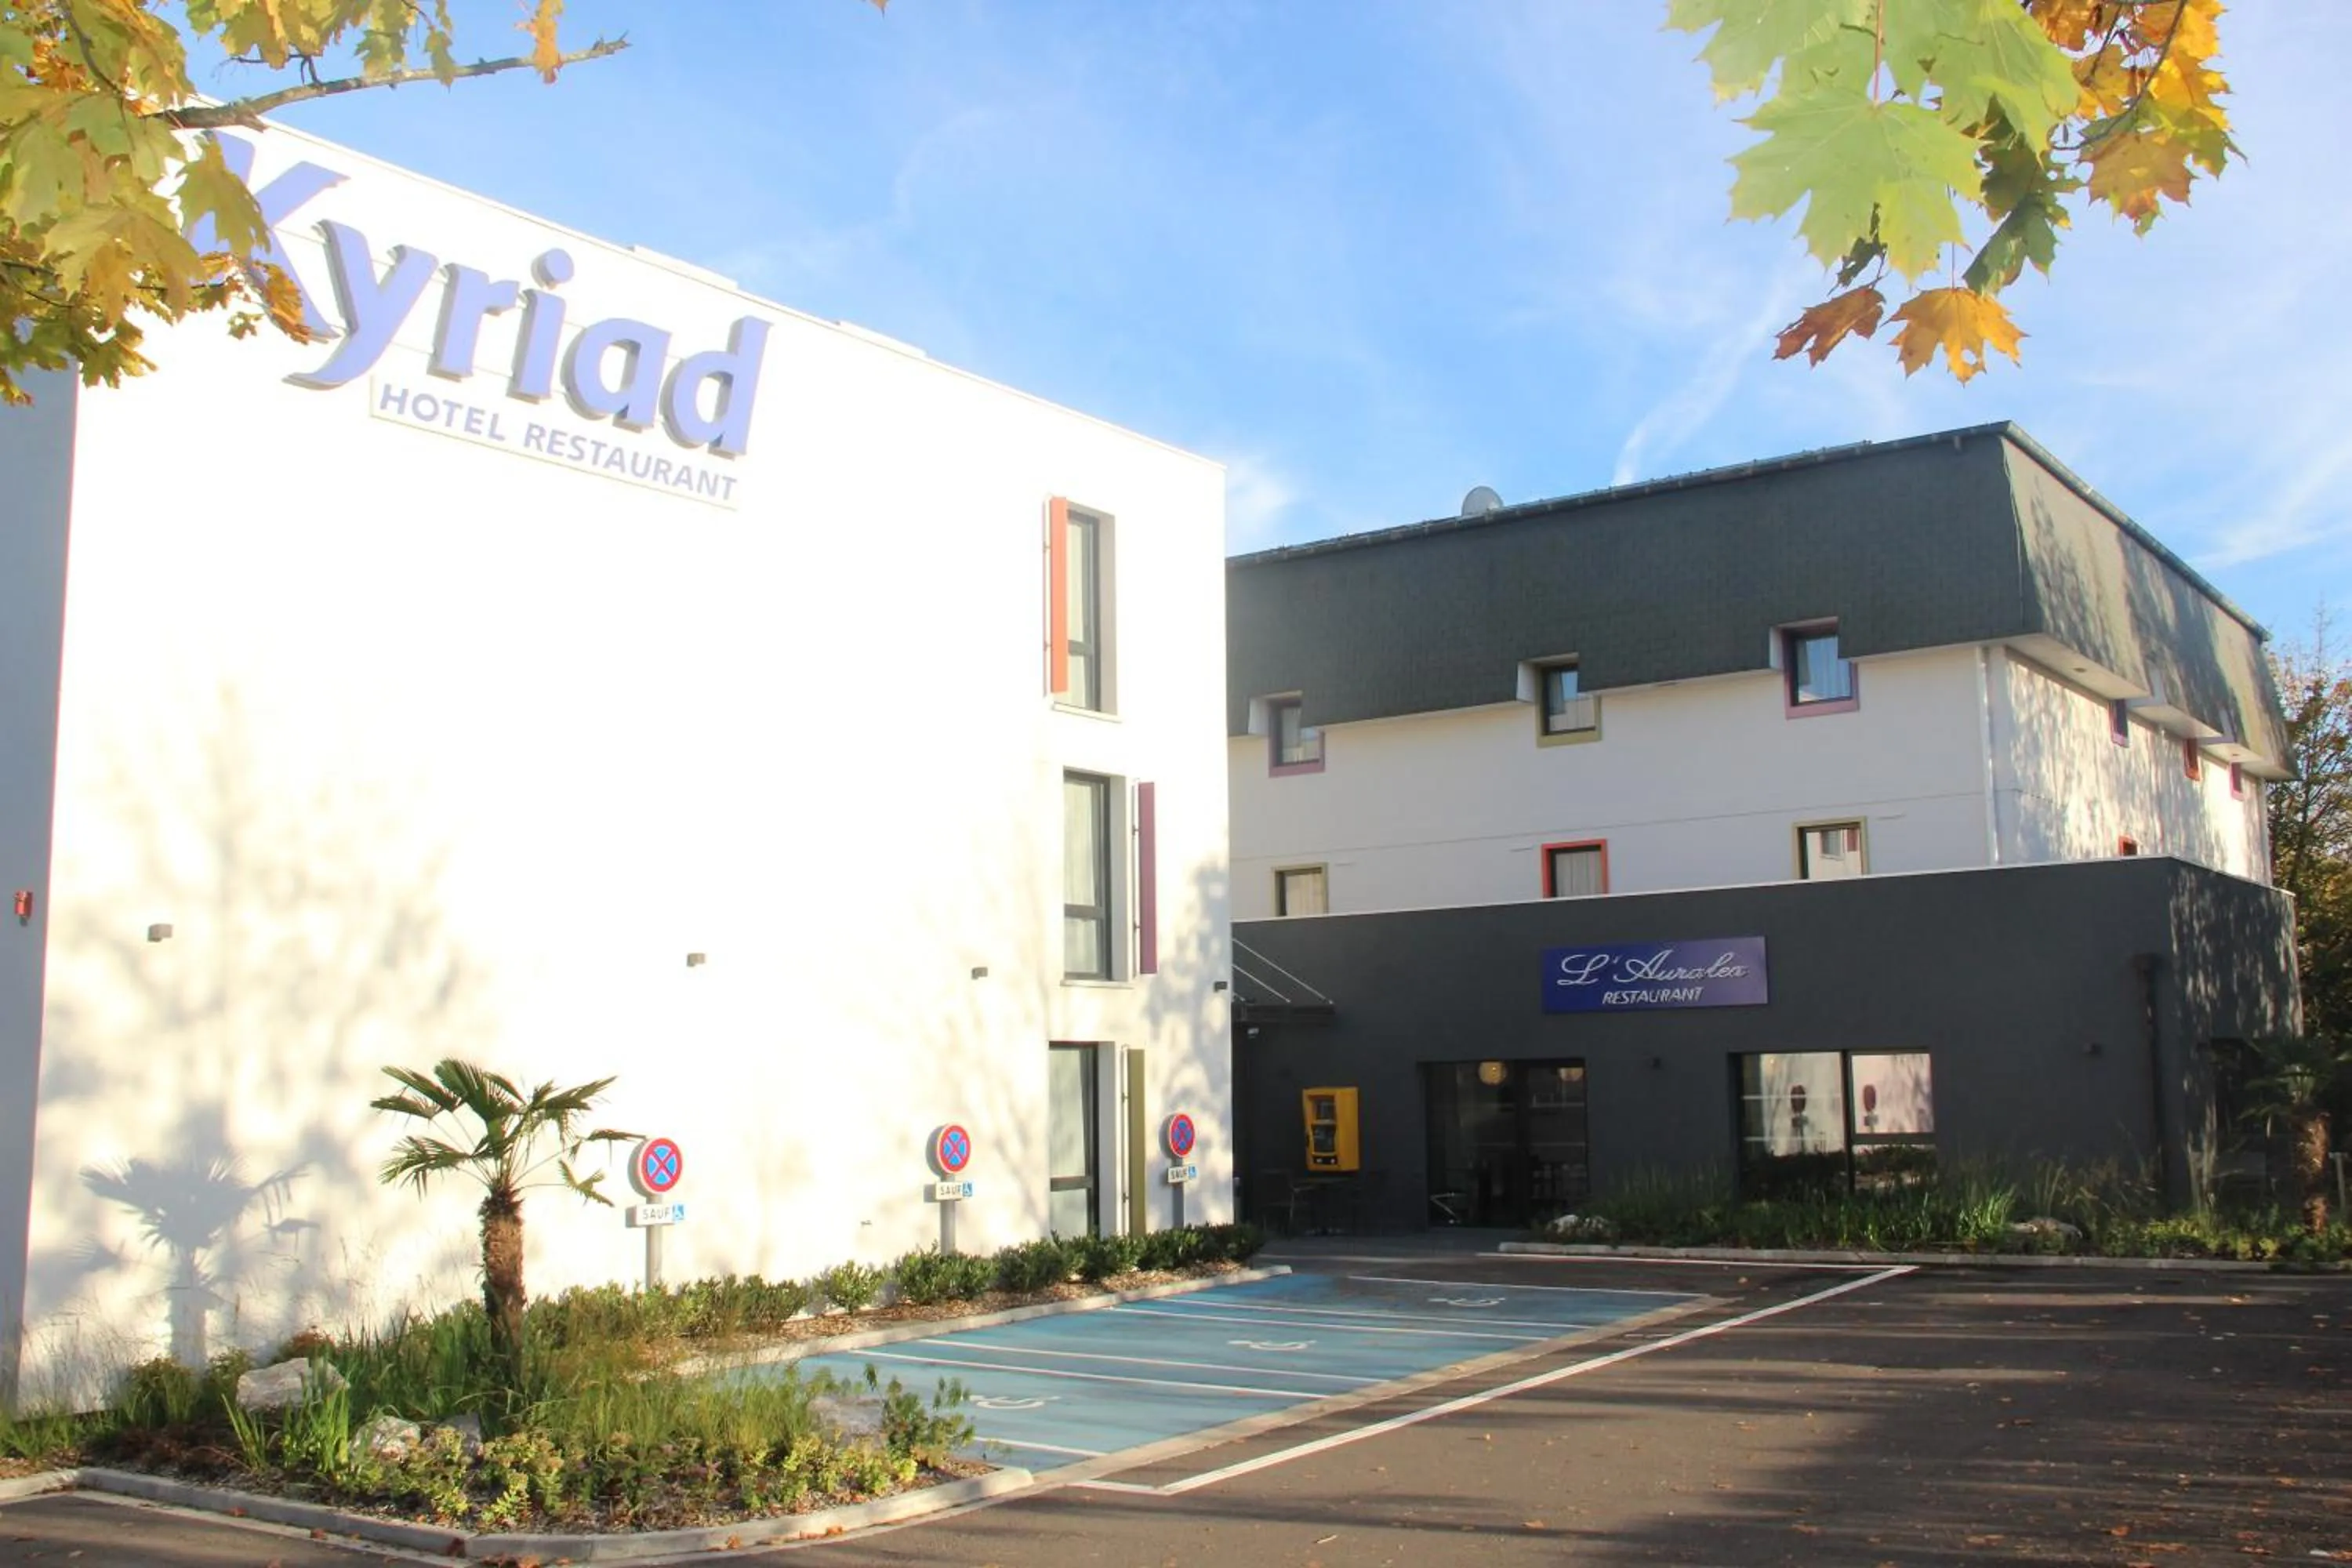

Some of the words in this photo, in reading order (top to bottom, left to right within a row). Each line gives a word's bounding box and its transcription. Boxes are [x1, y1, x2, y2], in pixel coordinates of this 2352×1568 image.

[379, 383, 506, 441] HOTEL
[523, 422, 737, 501] RESTAURANT
[1602, 986, 1704, 1005] RESTAURANT
[642, 1207, 670, 1220] SAUF
